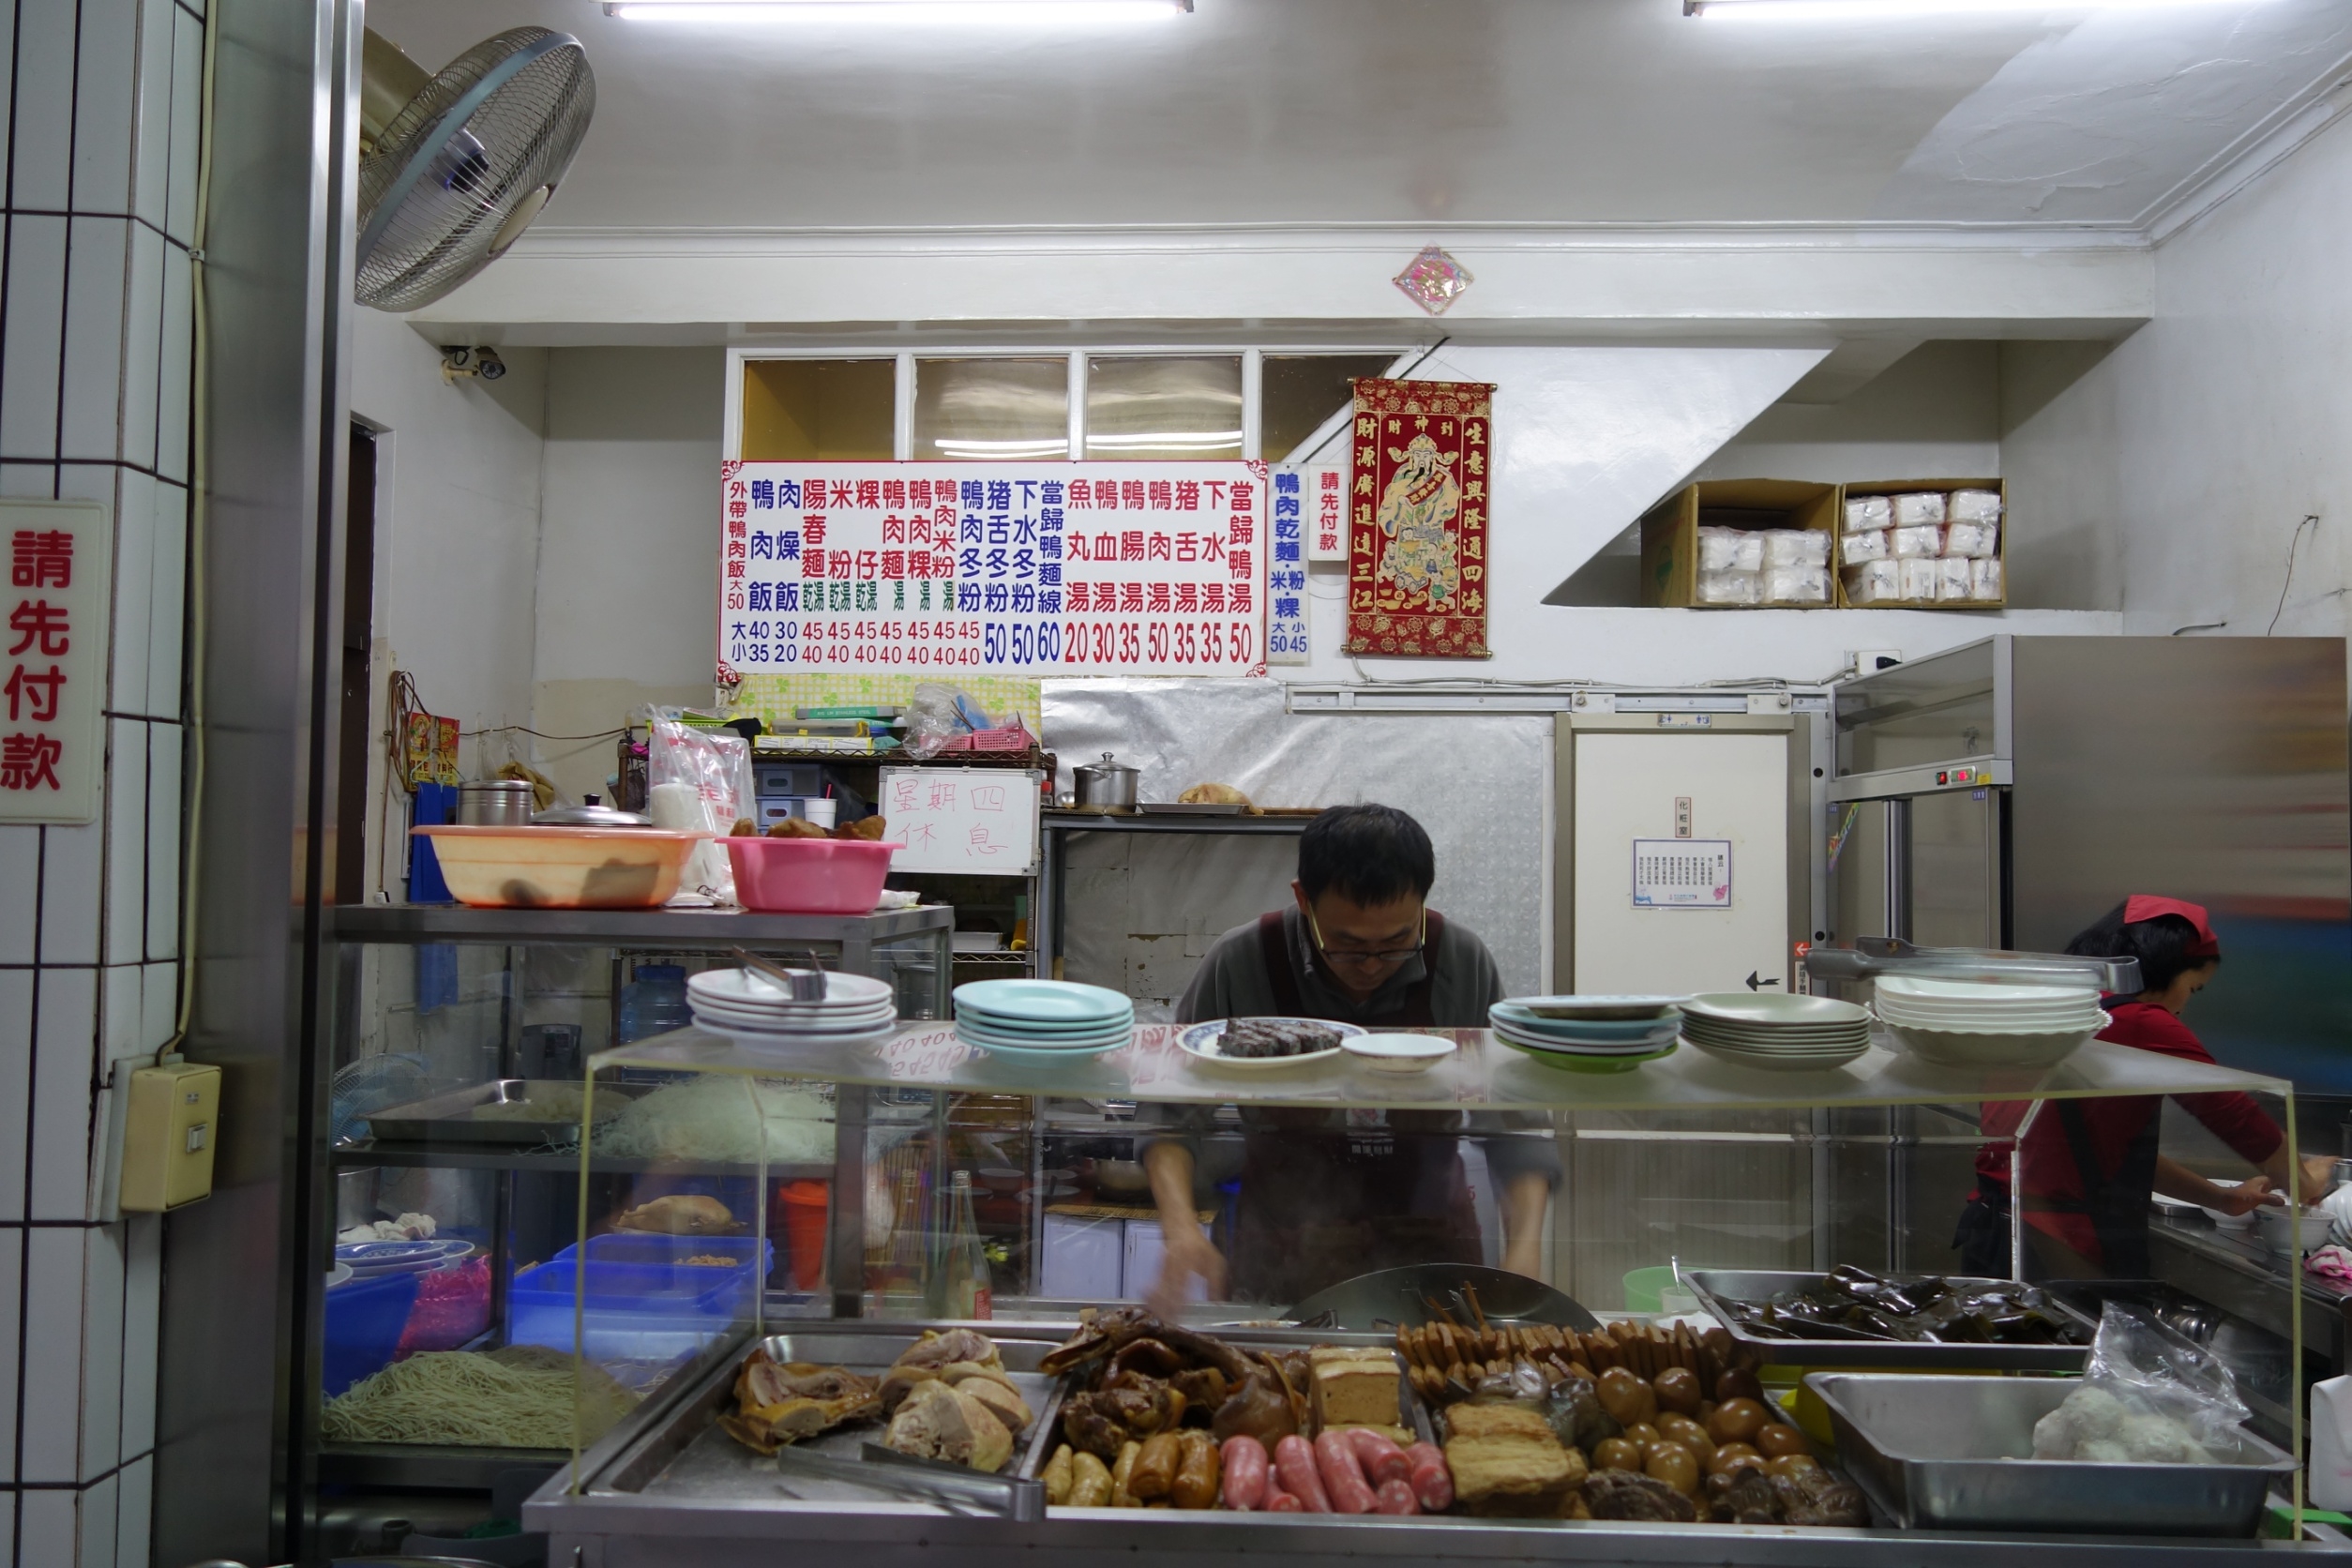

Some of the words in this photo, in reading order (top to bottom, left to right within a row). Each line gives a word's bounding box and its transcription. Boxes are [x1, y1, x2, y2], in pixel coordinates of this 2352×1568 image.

[1388, 415, 1454, 437] 財神到
[749, 480, 774, 611] 鴨肉飯
[776, 480, 800, 611] 肉燥飯
[958, 479, 983, 612] 鴨肉冬粉
[1012, 479, 1037, 613] 下水冬粉
[1038, 479, 1063, 613] 當歸鴨麵線
[1065, 478, 1092, 612] 魚丸湯
[1093, 479, 1118, 613] 鴨血湯
[1120, 479, 1145, 613] 鴨腸湯
[1147, 479, 1172, 613] 鴨肉湯
[1201, 479, 1227, 613] 下水湯
[1228, 479, 1253, 613] 當歸鴨湯
[1319, 472, 1340, 551] 請先付款
[0, 529, 74, 791] 請先付款
[731, 622, 746, 640] 大
[749, 621, 769, 640] 40
[776, 622, 797, 640] 30
[803, 622, 823, 640] 45
[828, 622, 850, 640] 45
[854, 622, 877, 640] 45
[881, 622, 902, 640] 45
[908, 622, 929, 640] 45
[934, 622, 955, 640] 45
[958, 622, 980, 640] 45
[731, 643, 746, 661] 小
[749, 644, 769, 662] 35
[775, 644, 797, 662] 20
[803, 645, 822, 663] 40
[828, 645, 850, 663] 40
[854, 645, 877, 663] 40
[880, 646, 902, 664] 40
[907, 646, 929, 664] 40
[933, 647, 955, 665] 40
[958, 648, 980, 665] 40
[985, 623, 1006, 664] 50
[1012, 623, 1033, 664] 50
[1038, 621, 1060, 662] 60
[1065, 622, 1088, 662] 20
[1093, 622, 1114, 663] 30
[1120, 622, 1139, 664] 35
[1149, 622, 1168, 663] 50
[1174, 622, 1195, 664] 35
[1201, 622, 1221, 663] 35
[1230, 623, 1251, 663] 50
[1270, 636, 1288, 653] 50
[1289, 636, 1307, 653] 45
[1273, 622, 1286, 633] 大
[1292, 622, 1304, 633] 小
[893, 778, 1005, 813] 星期四
[894, 822, 1009, 857] 休息
